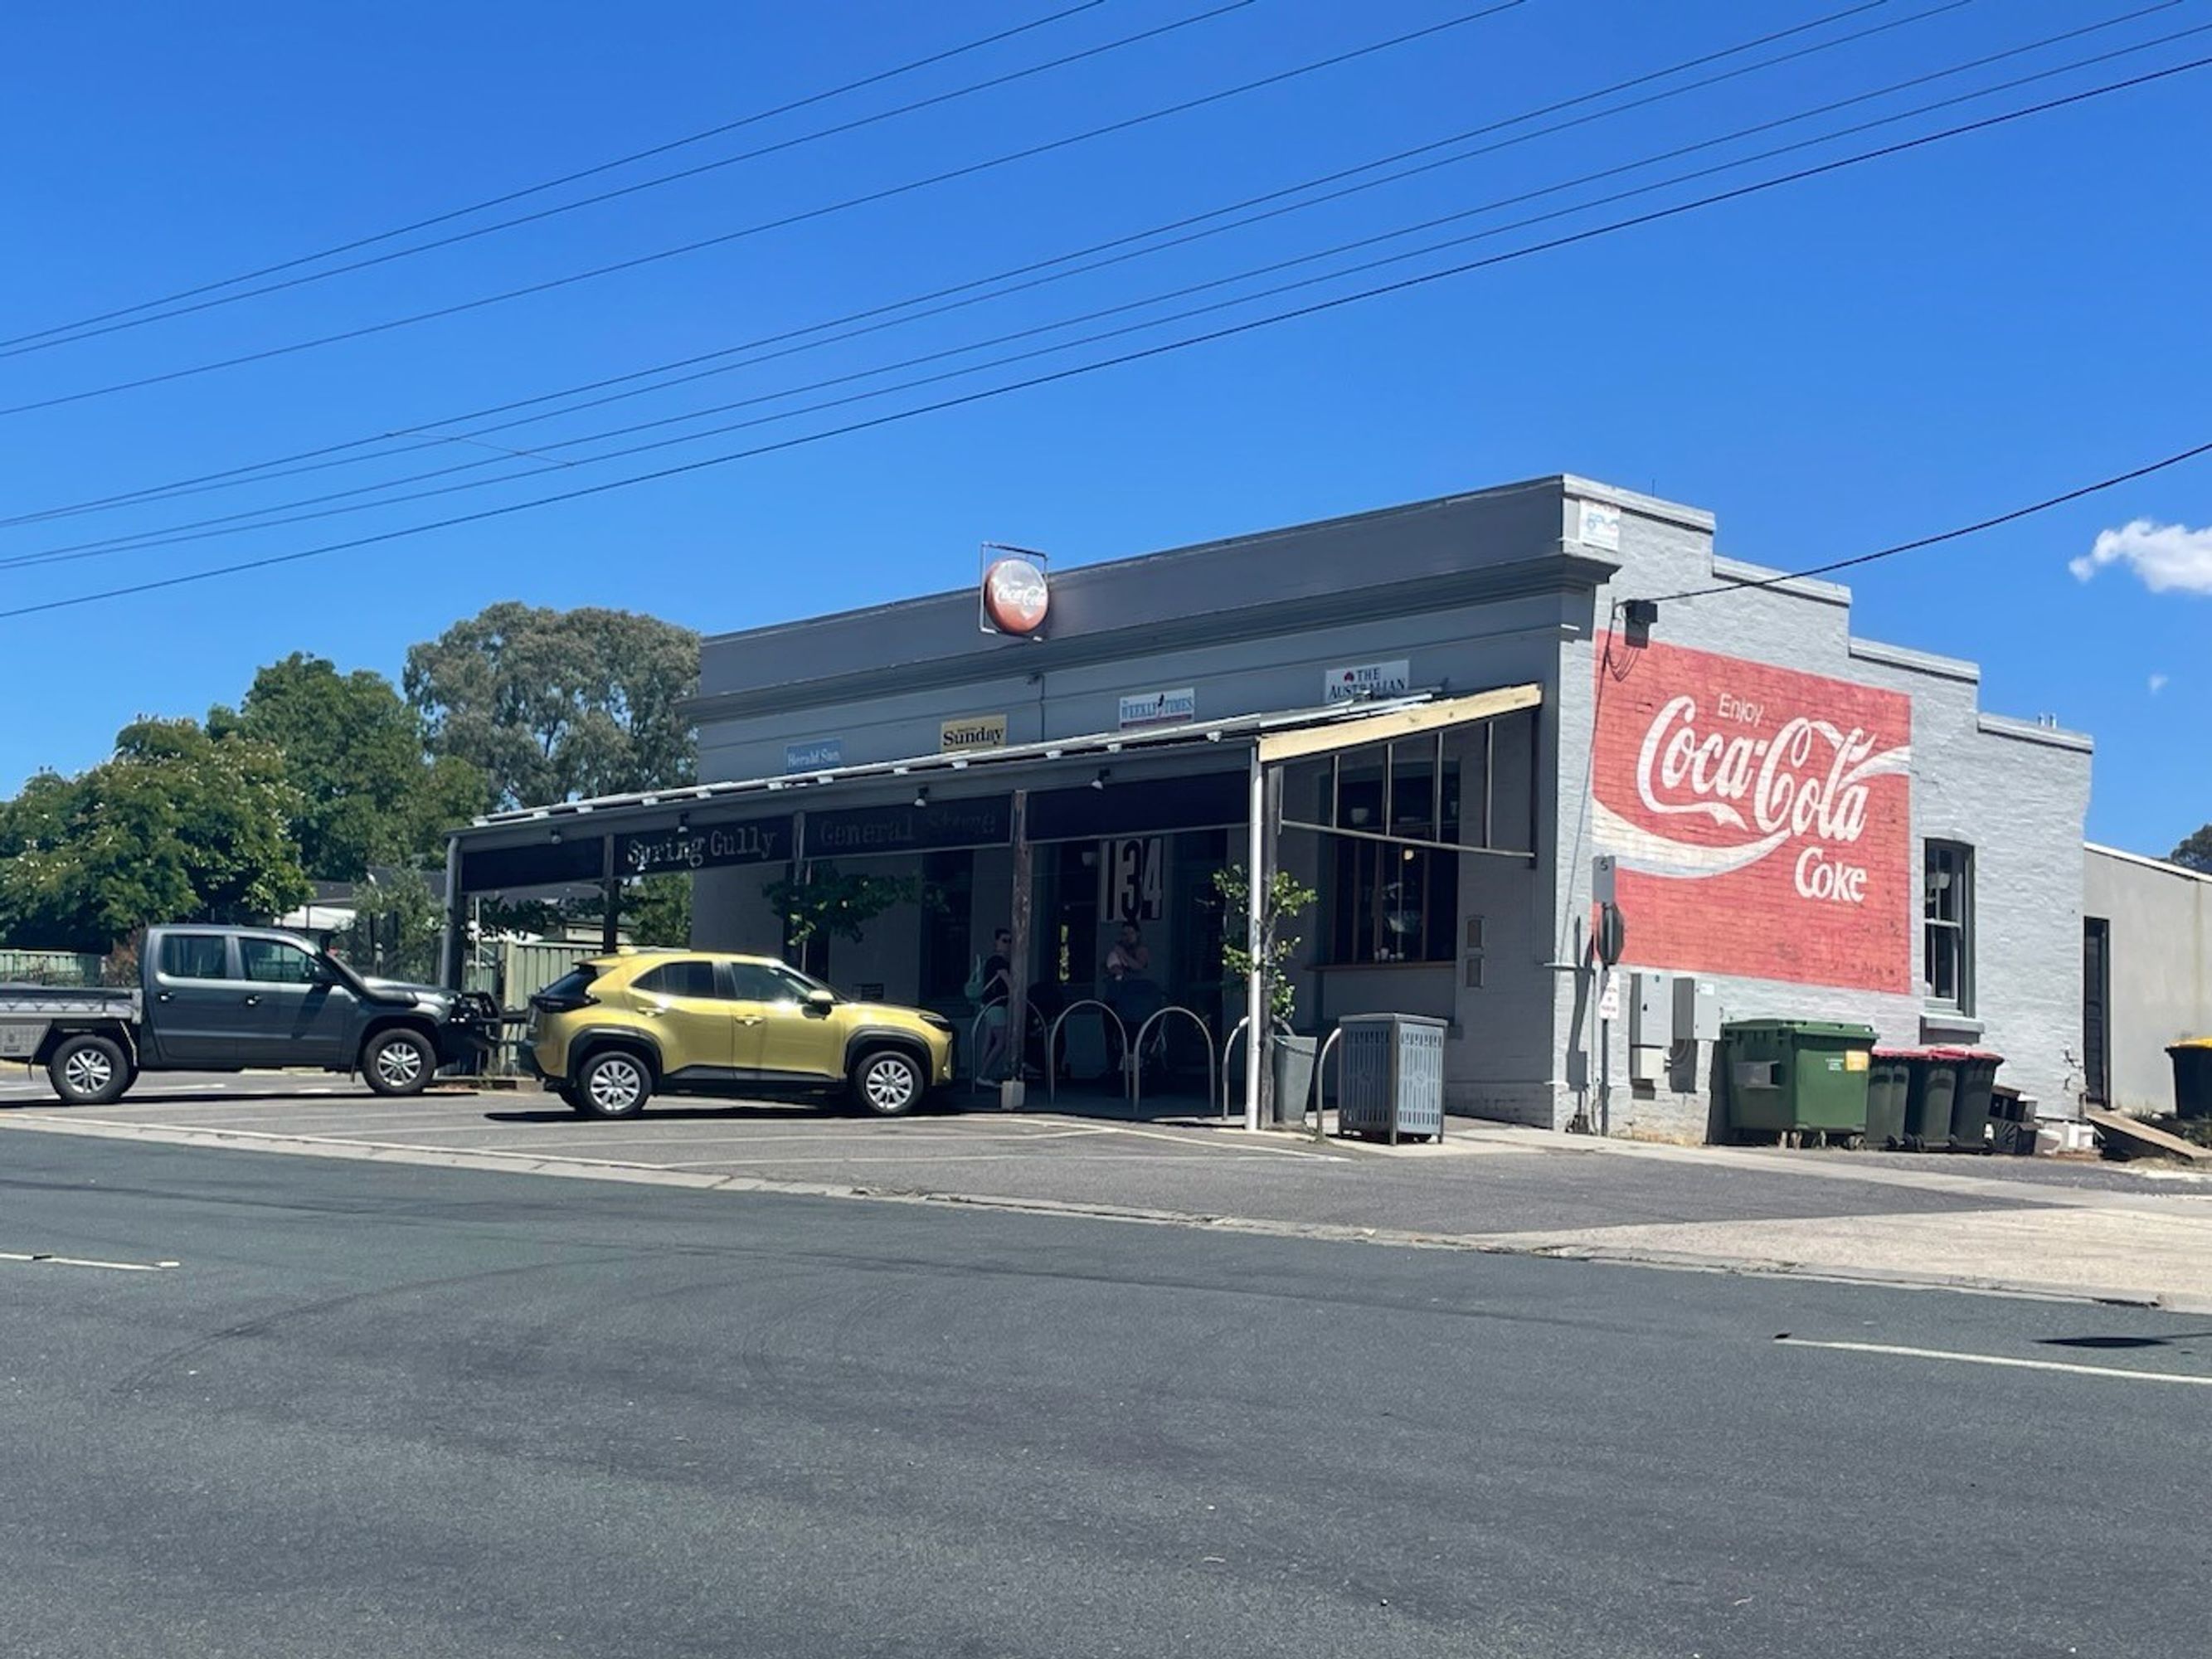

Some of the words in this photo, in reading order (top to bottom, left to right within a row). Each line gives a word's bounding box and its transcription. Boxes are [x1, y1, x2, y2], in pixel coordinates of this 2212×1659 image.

[1357, 667, 1380, 681] THE
[1717, 692, 1764, 728] Enjoy
[943, 727, 1004, 747] Sunday
[1636, 695, 1874, 841] Coca-Cola
[627, 838, 705, 871] Spring
[711, 826, 777, 859] Gully
[819, 814, 915, 847] General
[1795, 846, 1868, 903] Coke
